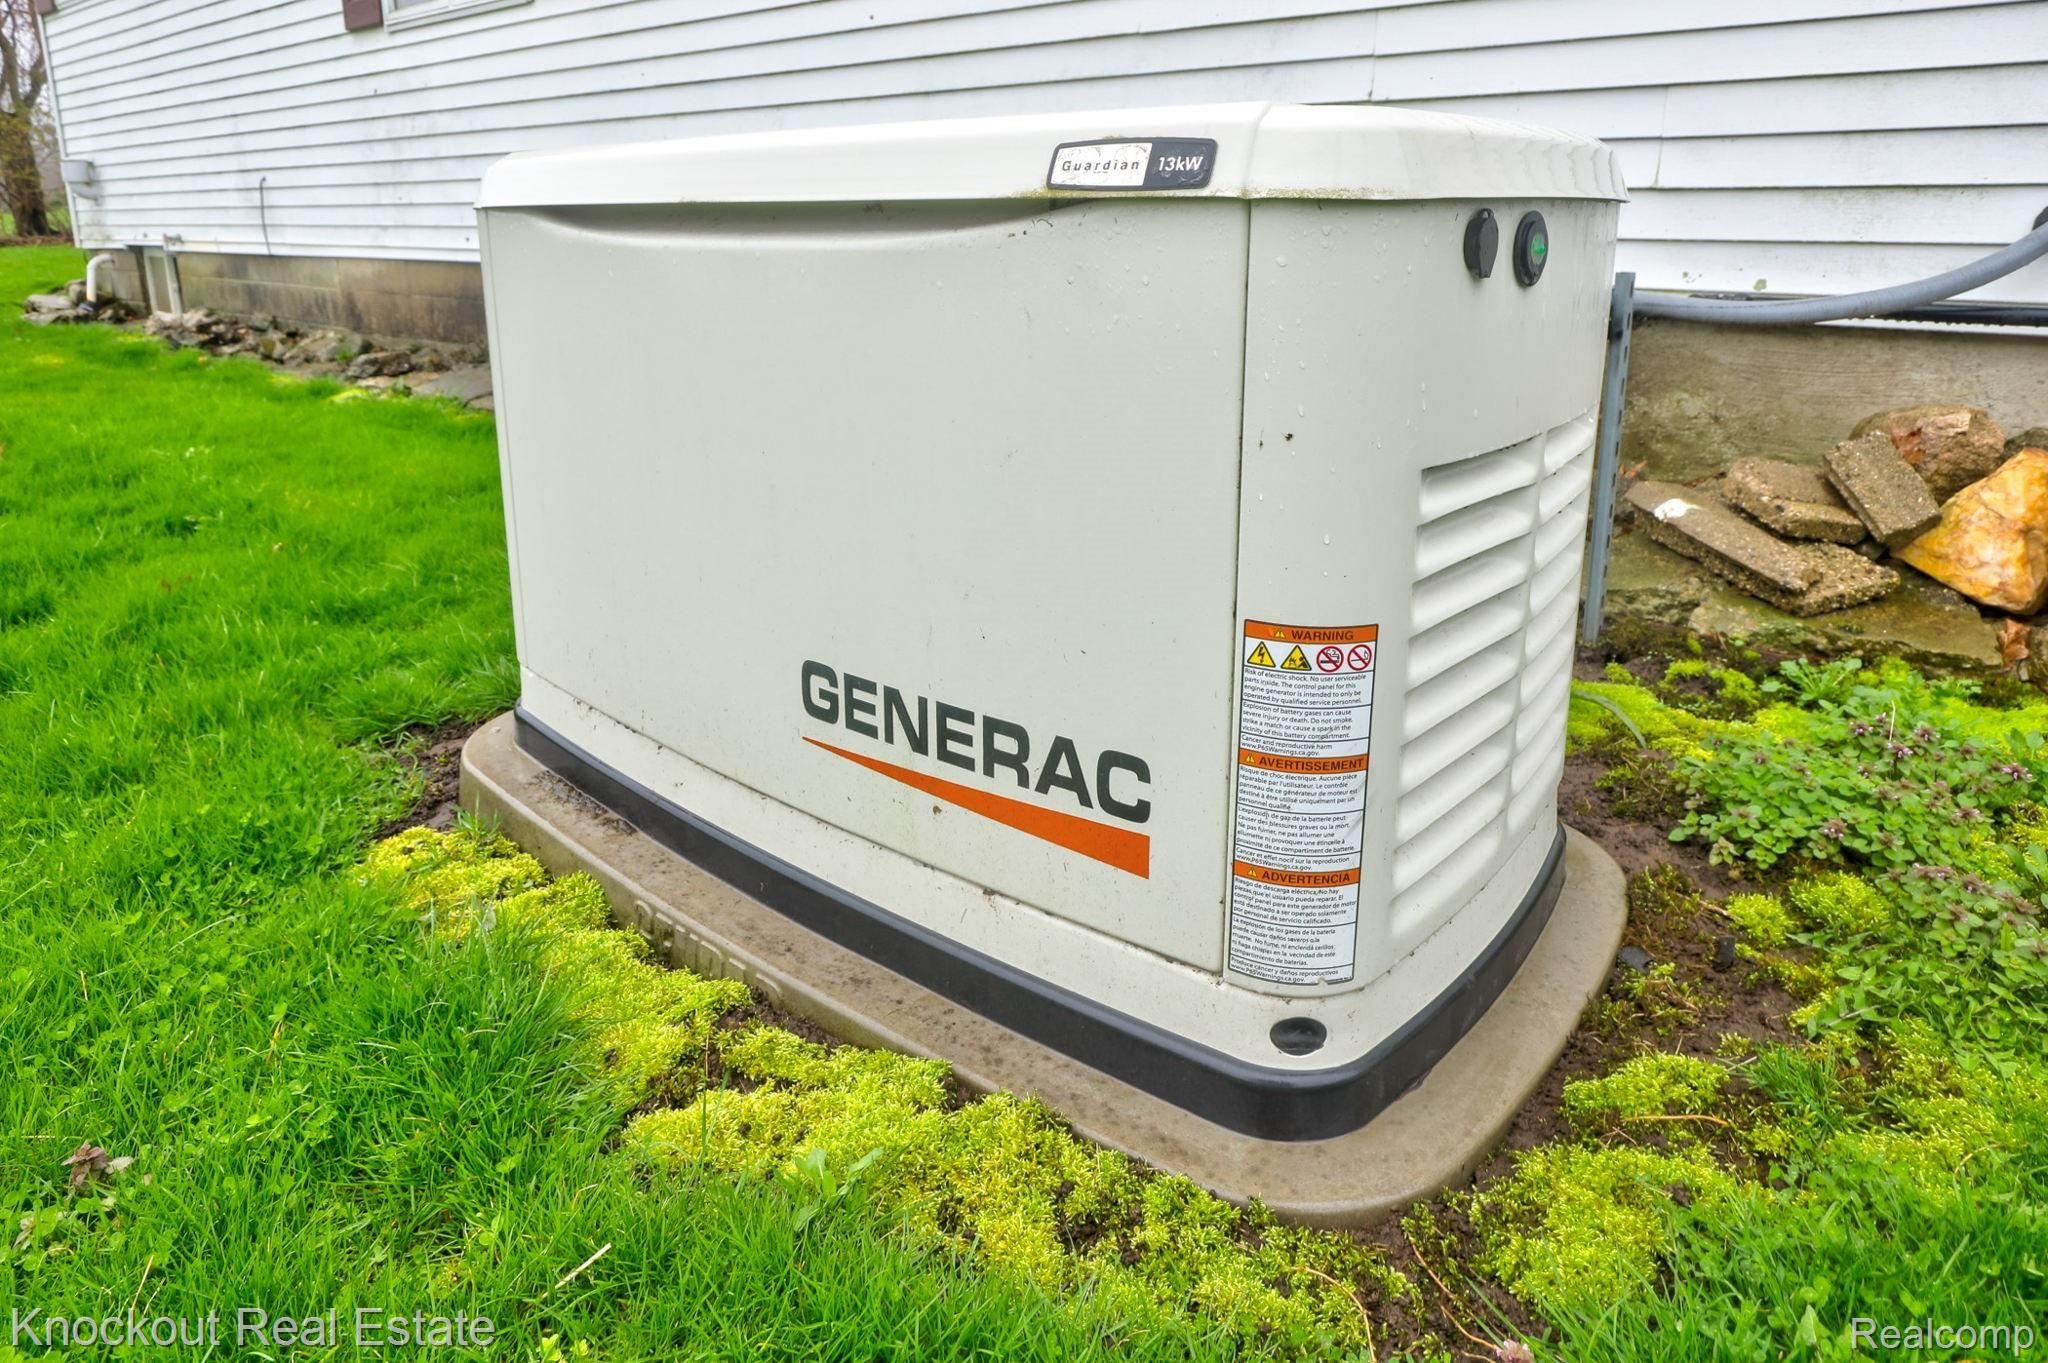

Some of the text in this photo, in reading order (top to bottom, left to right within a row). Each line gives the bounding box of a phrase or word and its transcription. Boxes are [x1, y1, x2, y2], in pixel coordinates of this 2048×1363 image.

[1062, 156, 1204, 172] Guardian 13kW
[1291, 630, 1354, 640] WARNING
[1262, 712, 1280, 722] injury
[1280, 707, 1303, 716] battery
[1284, 731, 1306, 740] battery
[802, 660, 1150, 824] GENERAC
[1259, 756, 1364, 771] AVERTISSEMENT
[1262, 870, 1350, 884] ADVERTENCIA
